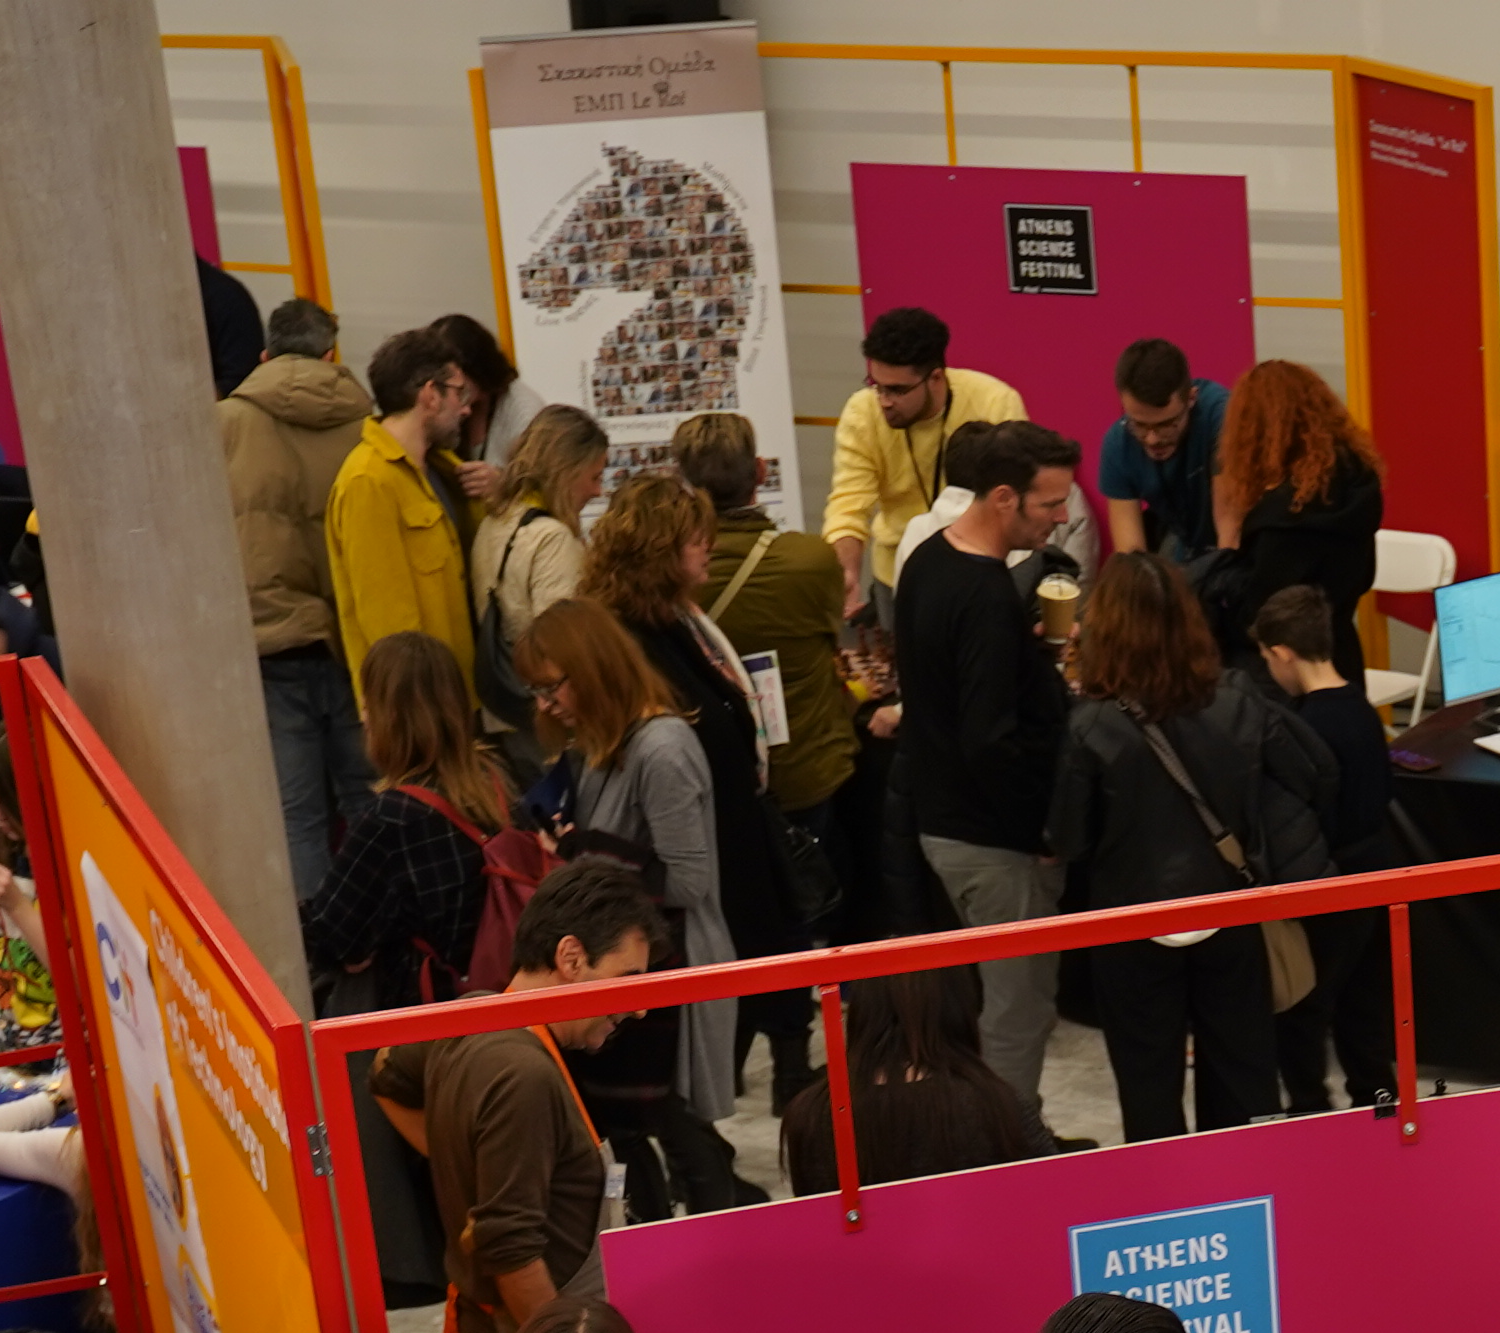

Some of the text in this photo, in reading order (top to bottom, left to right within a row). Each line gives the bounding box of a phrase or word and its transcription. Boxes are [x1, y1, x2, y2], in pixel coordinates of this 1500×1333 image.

[1017, 217, 1075, 237] ATHENS
[1017, 239, 1077, 258] SCIENCE
[1019, 260, 1086, 280] FESTIVAL
[1103, 1232, 1229, 1279] ATHENS
